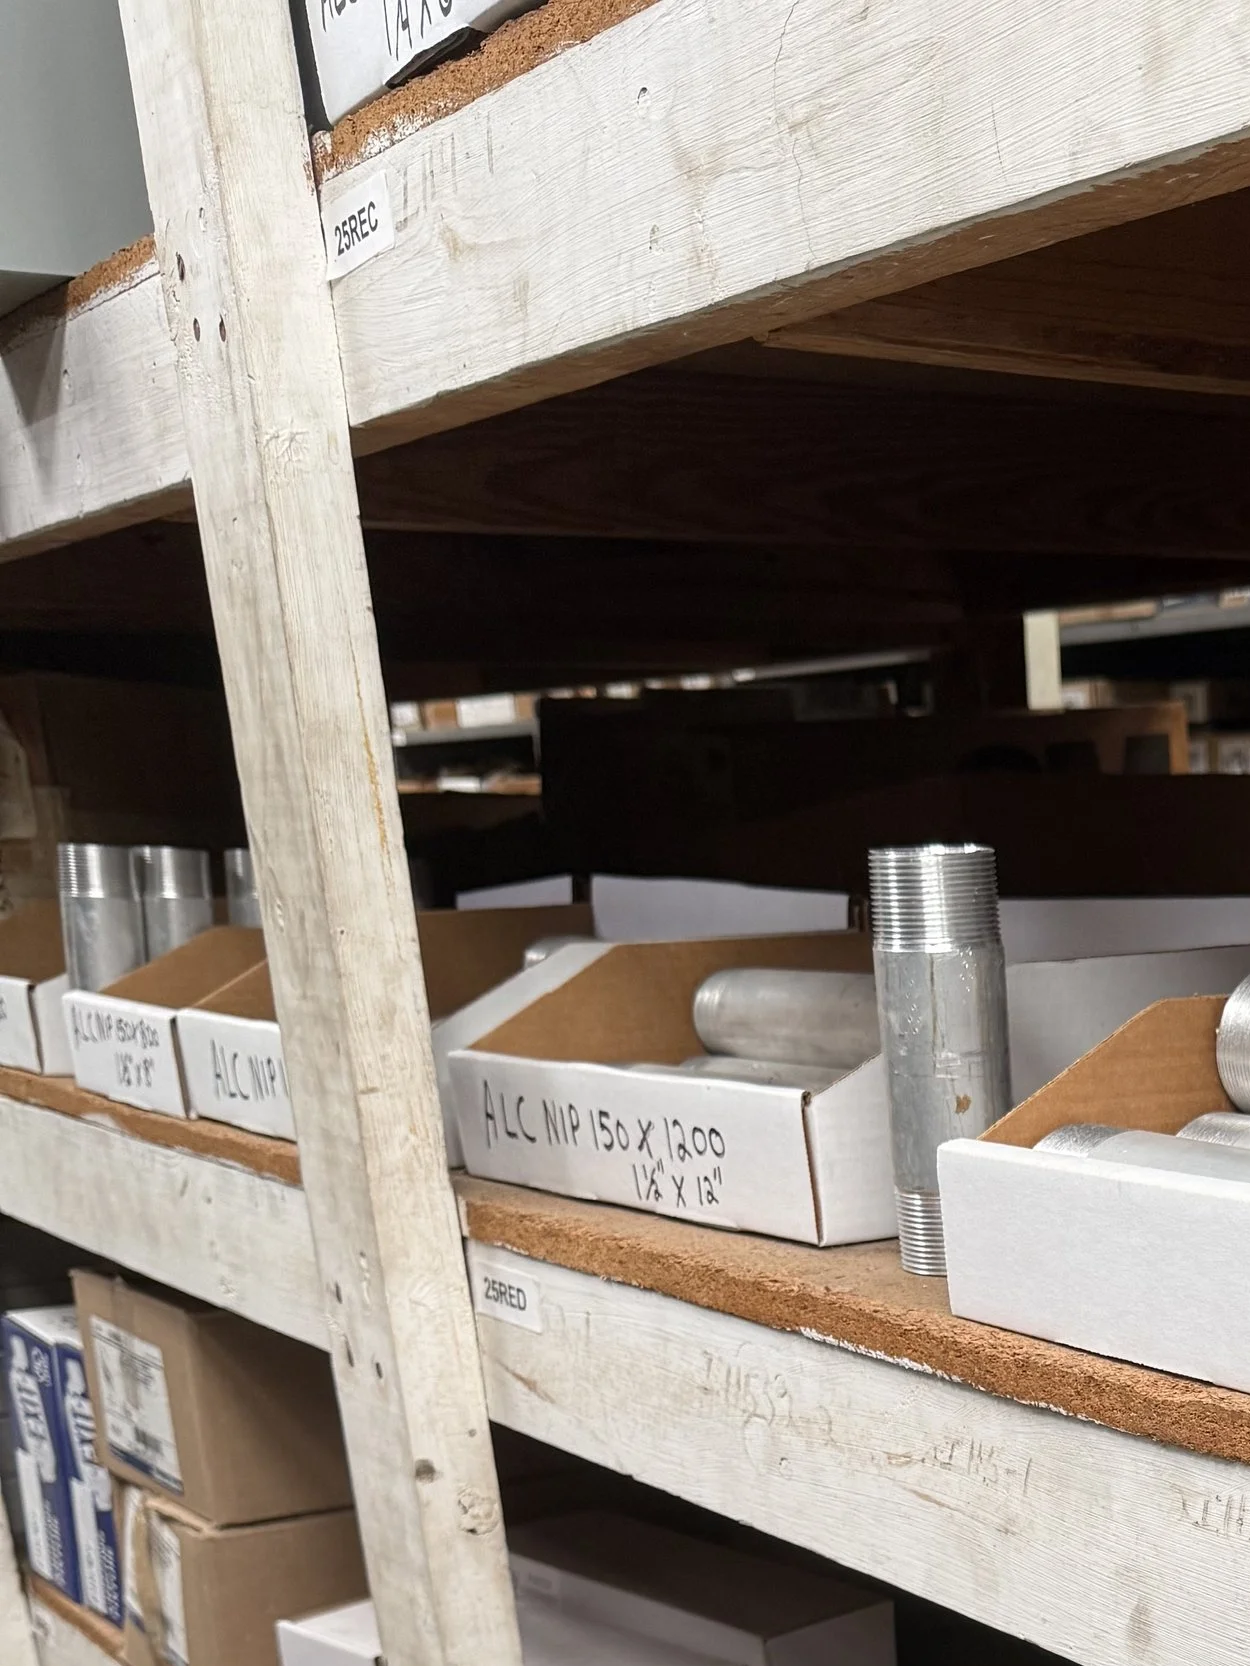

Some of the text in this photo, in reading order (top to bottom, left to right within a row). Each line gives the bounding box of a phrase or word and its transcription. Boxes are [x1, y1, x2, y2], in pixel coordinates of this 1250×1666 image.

[334, 200, 379, 256] 25REC
[71, 1003, 98, 1051] ALC
[211, 1038, 250, 1101] ALC
[248, 1055, 277, 1101] NIP
[483, 1079, 537, 1149] ALC
[542, 1099, 581, 1147] NIP
[484, 1276, 527, 1311] 25RED
